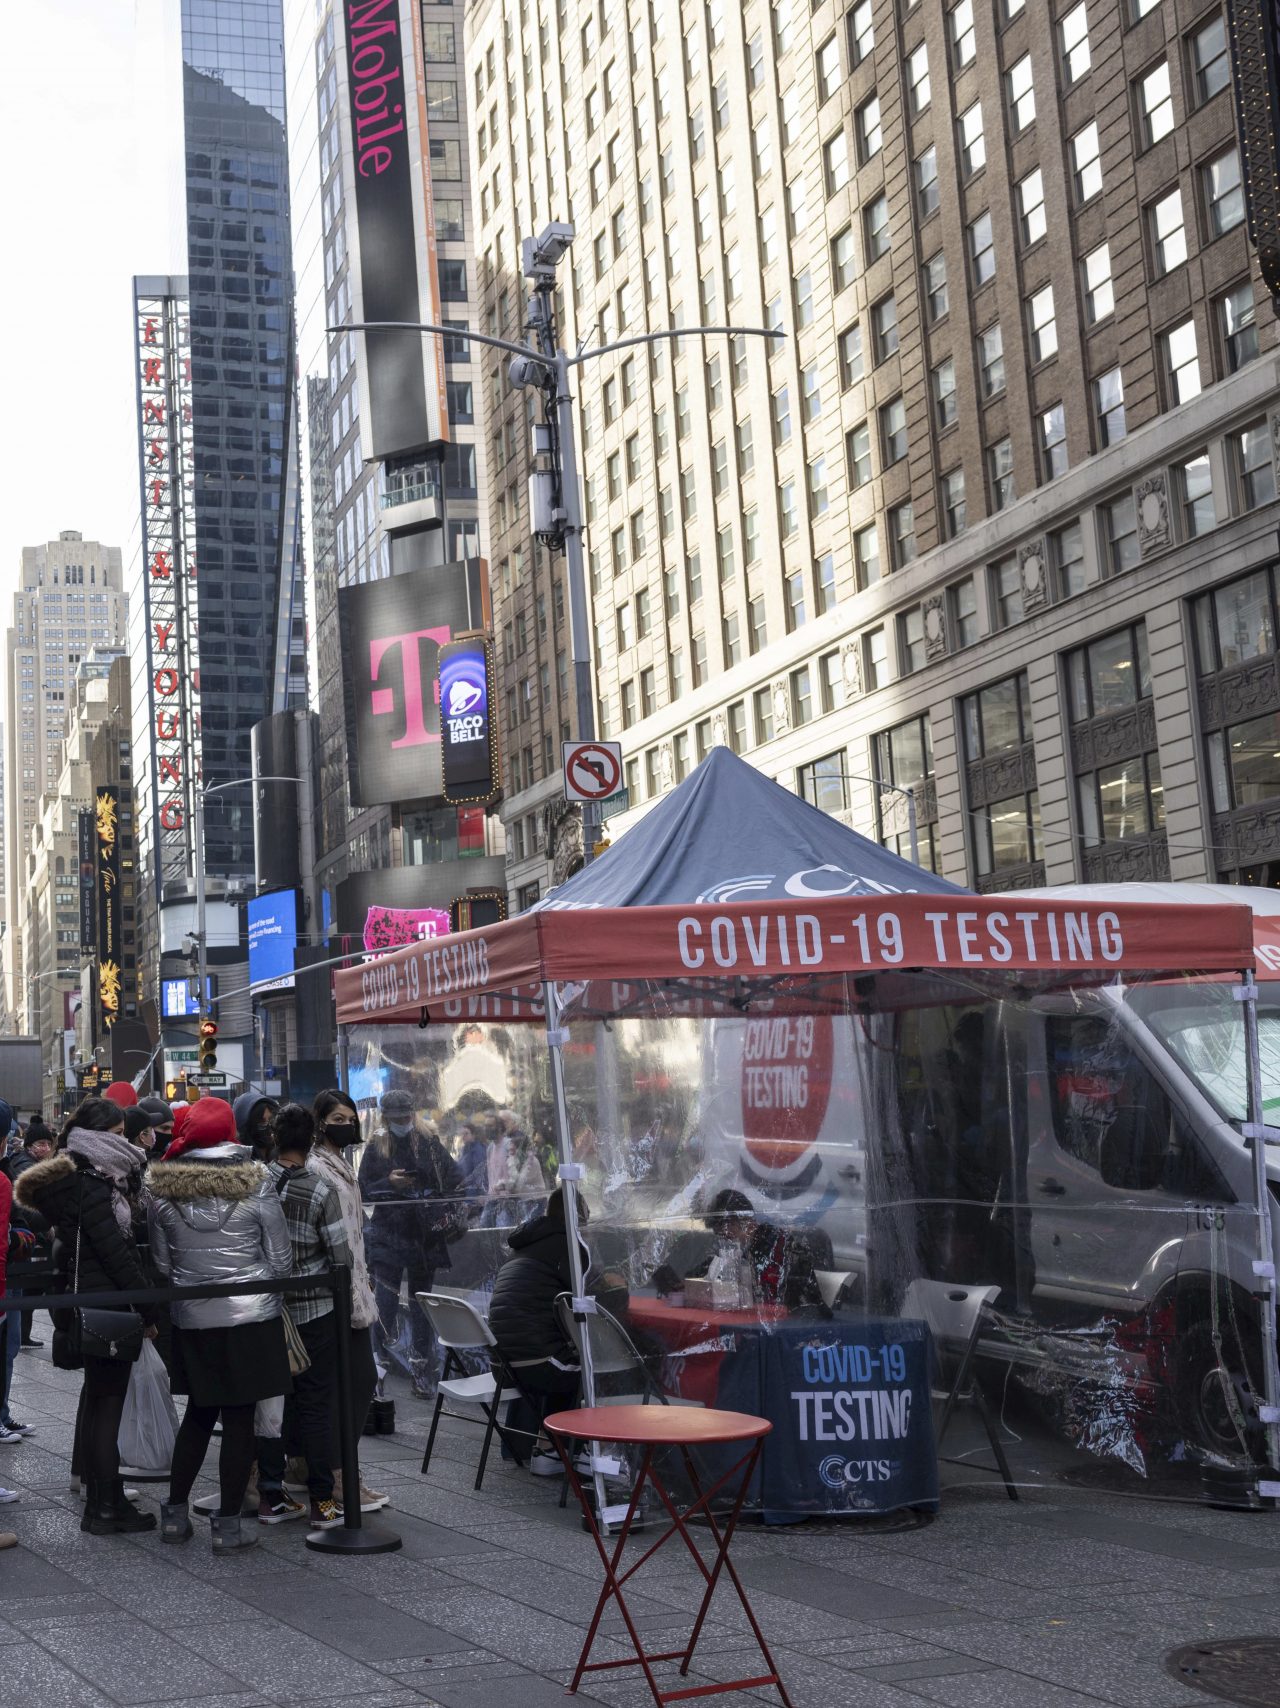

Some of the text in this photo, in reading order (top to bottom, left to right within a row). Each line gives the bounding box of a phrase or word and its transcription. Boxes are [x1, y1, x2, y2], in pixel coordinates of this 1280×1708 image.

[349, 0, 404, 177] Mobile
[143, 318, 183, 830] ERNST & YOUNG
[447, 715, 483, 731] TACO
[449, 728, 484, 744] BELL
[677, 910, 1124, 969] COVID-19 TESTING
[362, 937, 490, 1013] COVID-19 TESTING
[181, 1051, 191, 1060] 44
[745, 1016, 814, 1060] COVID-19
[745, 1065, 808, 1108] TESTING
[803, 1344, 905, 1383] COVID-19
